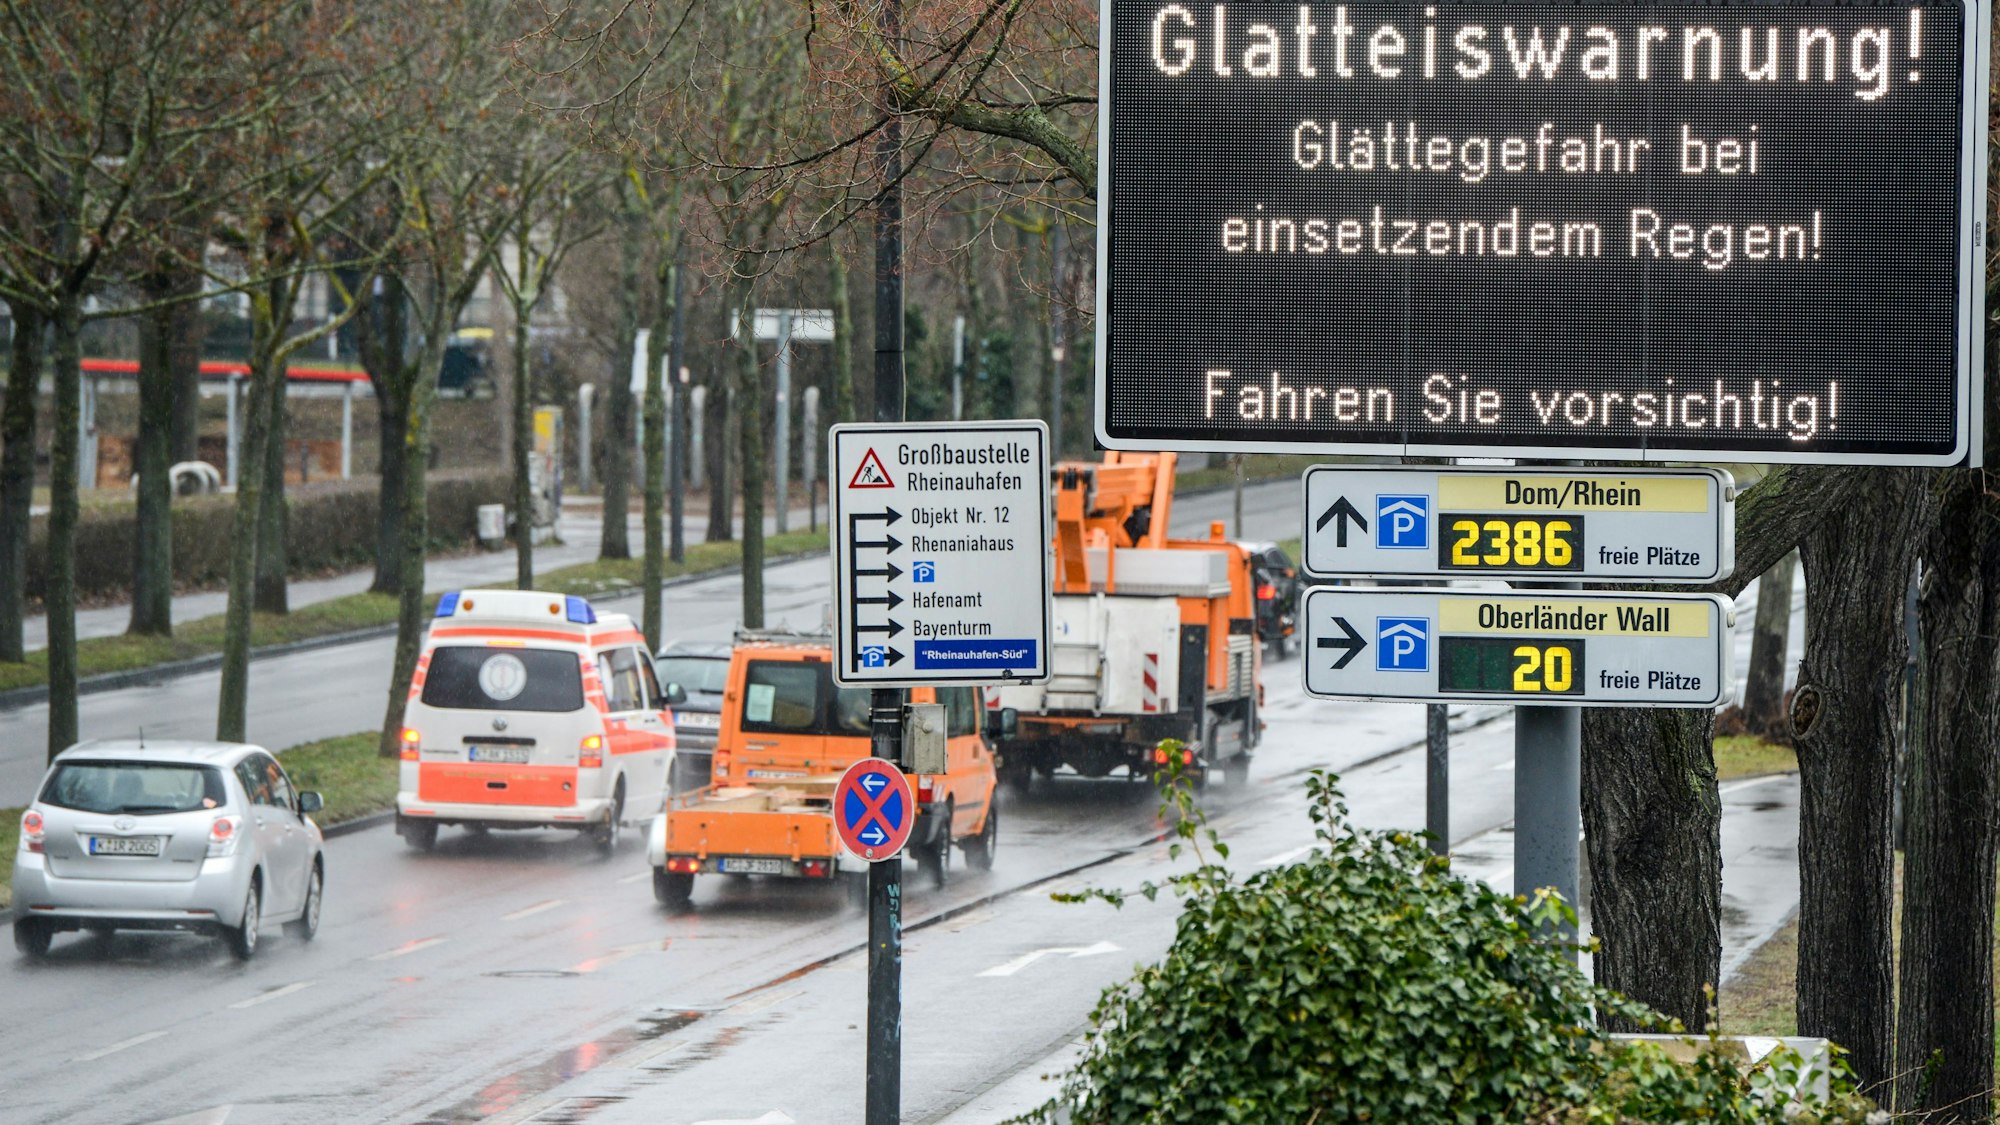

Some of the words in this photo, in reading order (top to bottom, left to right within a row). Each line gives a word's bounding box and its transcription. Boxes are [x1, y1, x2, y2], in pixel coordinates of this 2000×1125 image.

[1152, 3, 1921, 101] Glatteiswarnung!
[1294, 120, 1650, 182] Glättegefahr
[1682, 124, 1757, 174] bei
[1222, 204, 1601, 257] einsetzendem
[1631, 209, 1821, 270] Regen!
[1206, 370, 1392, 422] Fahren
[1423, 374, 1500, 424] Sie
[1531, 379, 1837, 441] vorsichtig!
[898, 442, 1030, 466] Großbaustelle
[908, 471, 1022, 492] Rheinauhafen
[1505, 479, 1642, 509] Dom/Rhein
[911, 507, 958, 529] Objekt
[966, 506, 986, 524] Nr.
[994, 506, 1009, 523] 12
[912, 534, 1014, 552] Rhenaniahaus
[1452, 520, 1572, 566] 2386
[1599, 545, 1639, 566] freie
[1647, 546, 1701, 566] Plätze
[913, 591, 982, 608] Hafenamt
[913, 619, 992, 640] Bayenturm
[1478, 603, 1609, 632] Oberländer
[1616, 606, 1670, 632] Wall
[1513, 646, 1572, 692] 20
[1600, 669, 1640, 690] freie
[1648, 670, 1701, 691] Plätze
